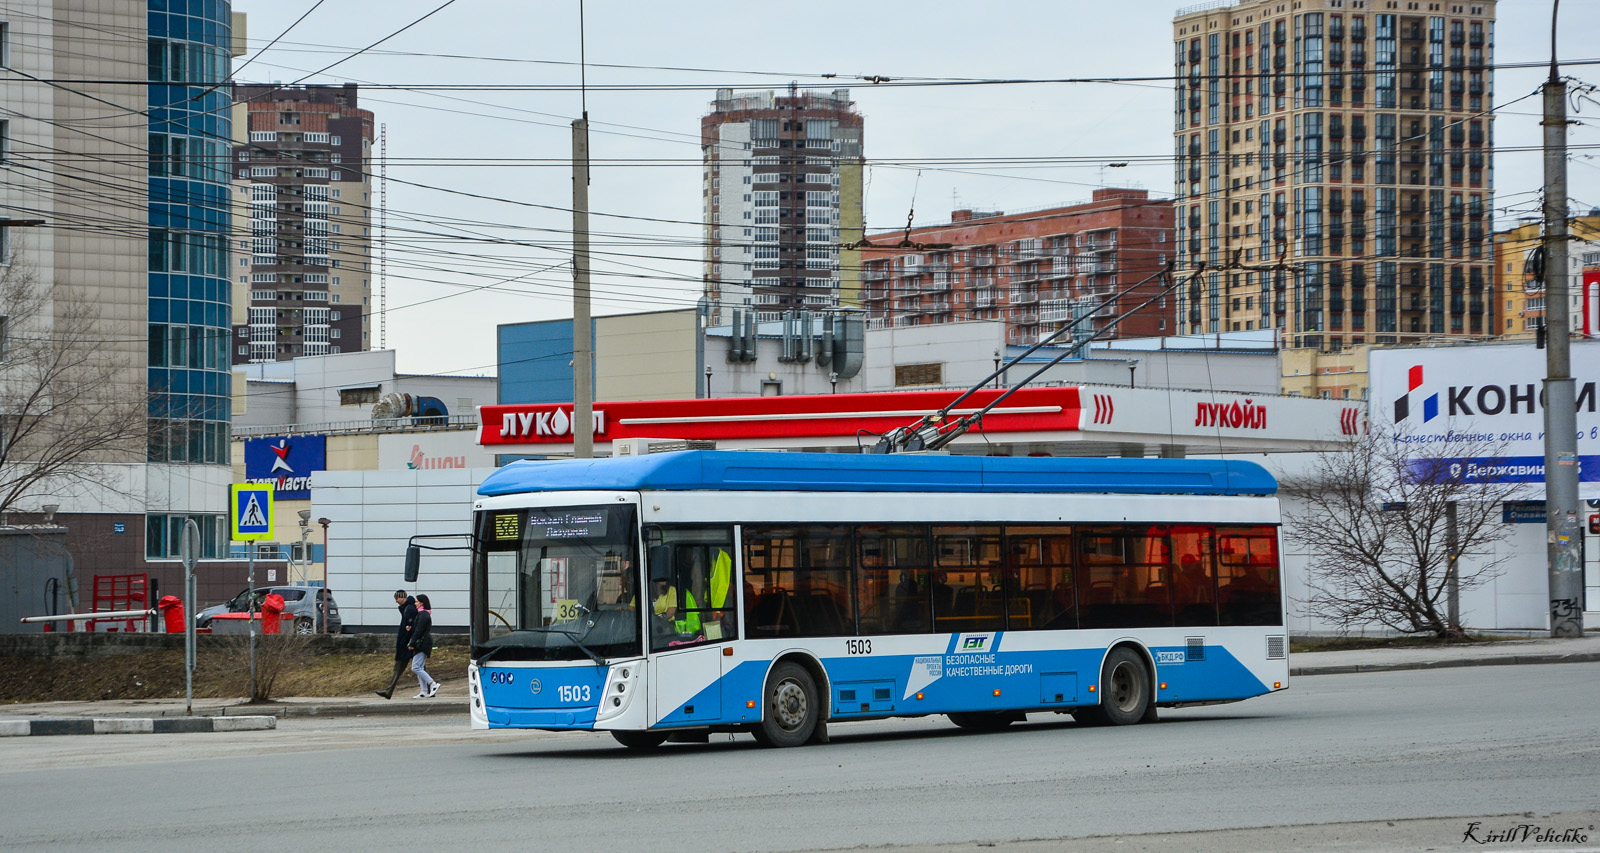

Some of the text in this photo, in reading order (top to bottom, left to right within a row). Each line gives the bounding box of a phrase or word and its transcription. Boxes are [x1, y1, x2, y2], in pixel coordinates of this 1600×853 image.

[500, 407, 605, 436] ЛУКОЛ
[1195, 399, 1266, 429] ЛУКОЙЛ
[1393, 430, 1495, 443] Качественные
[1500, 431, 1532, 442] окна
[560, 604, 576, 619] 36
[846, 639, 872, 655] 1503
[946, 654, 996, 665] БЕЗОПАСНЫЕ
[946, 664, 1033, 677] КАЧЕСТВЕННЫЕ ДОРОГИ
[557, 684, 591, 702] 1503
